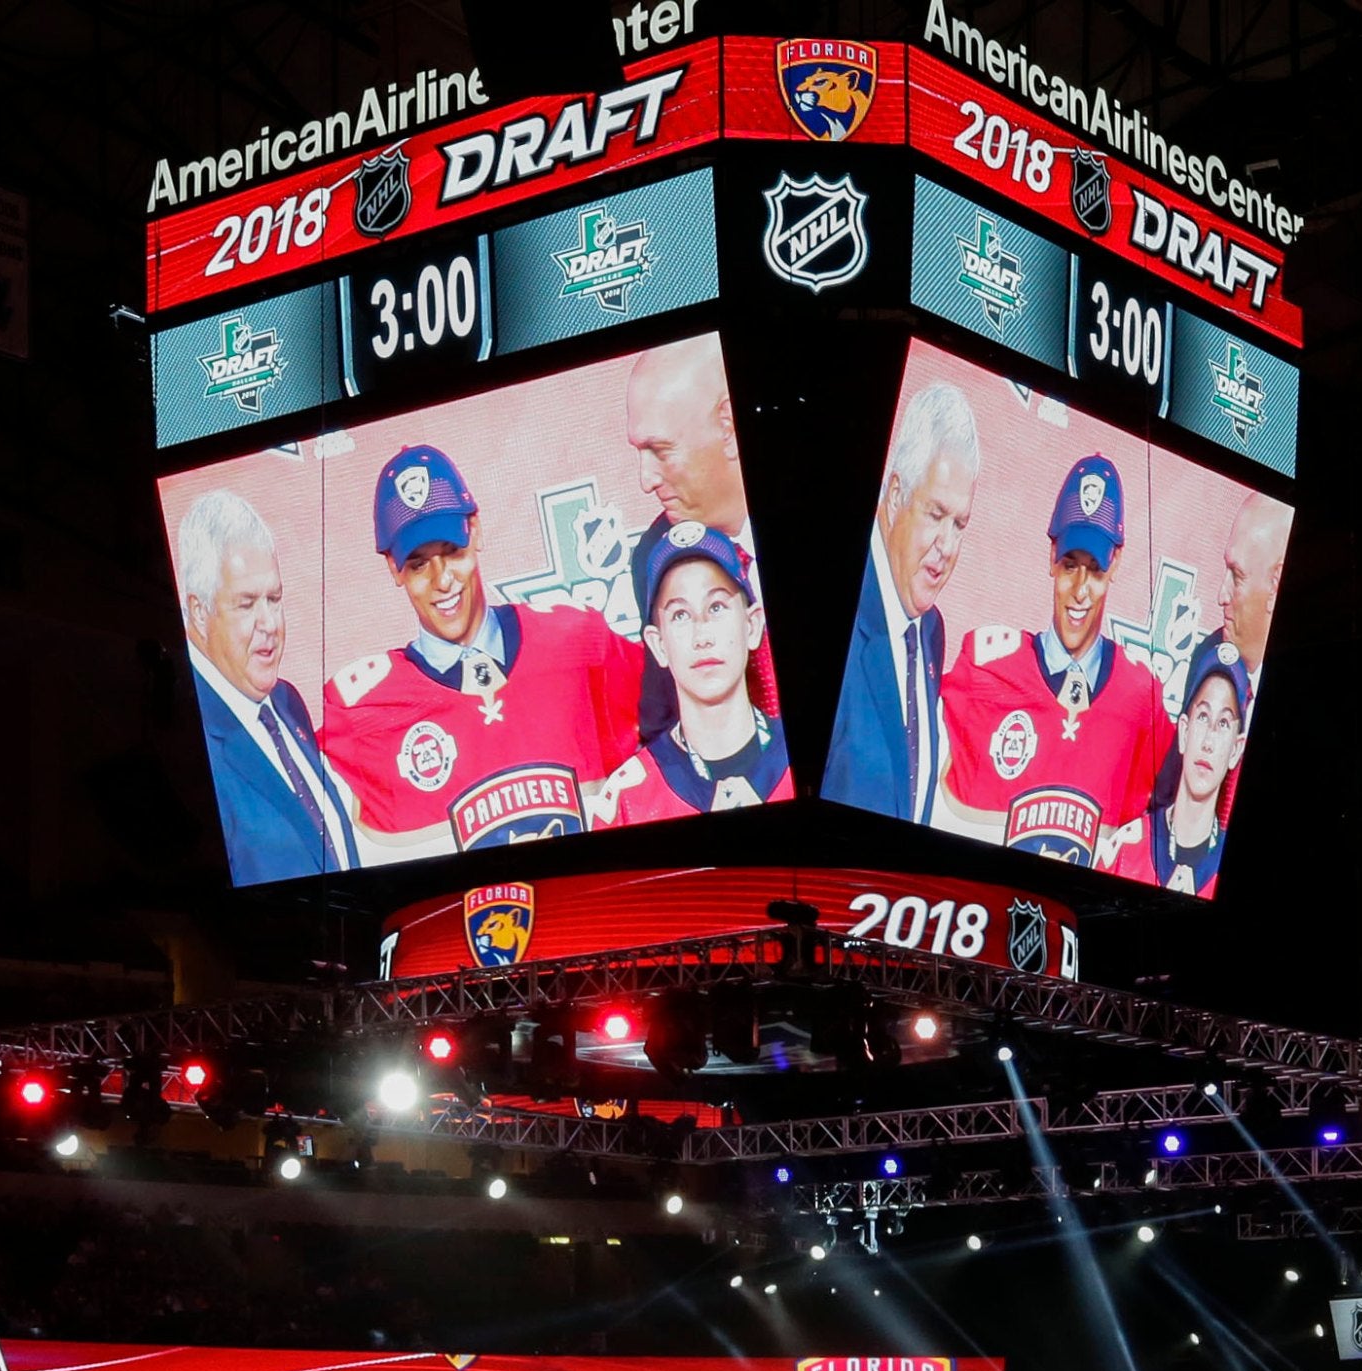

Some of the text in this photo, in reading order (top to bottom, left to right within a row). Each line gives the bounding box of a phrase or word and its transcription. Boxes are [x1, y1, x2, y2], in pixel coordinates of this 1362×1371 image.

[786, 42, 868, 64] FLORIDA
[923, 0, 1304, 244] AmericanAirlinesCenter
[205, 69, 683, 277] 2018 NHL DRAFT
[953, 102, 1278, 307] 2018 NHL DRAFT
[569, 237, 649, 278] DRAFT
[788, 205, 846, 260] NHL
[965, 250, 1022, 292] DRAFT
[371, 256, 475, 359] 3:00
[1090, 282, 1161, 385] 3:00
[211, 344, 279, 380] DRAFT
[1218, 373, 1265, 409] DRAFT
[464, 780, 569, 830] PANTHERS
[1016, 805, 1093, 840] PANTHERS
[469, 884, 527, 907] FLORIDA
[846, 891, 989, 958] 2018
[1016, 926, 1041, 965] NHL
